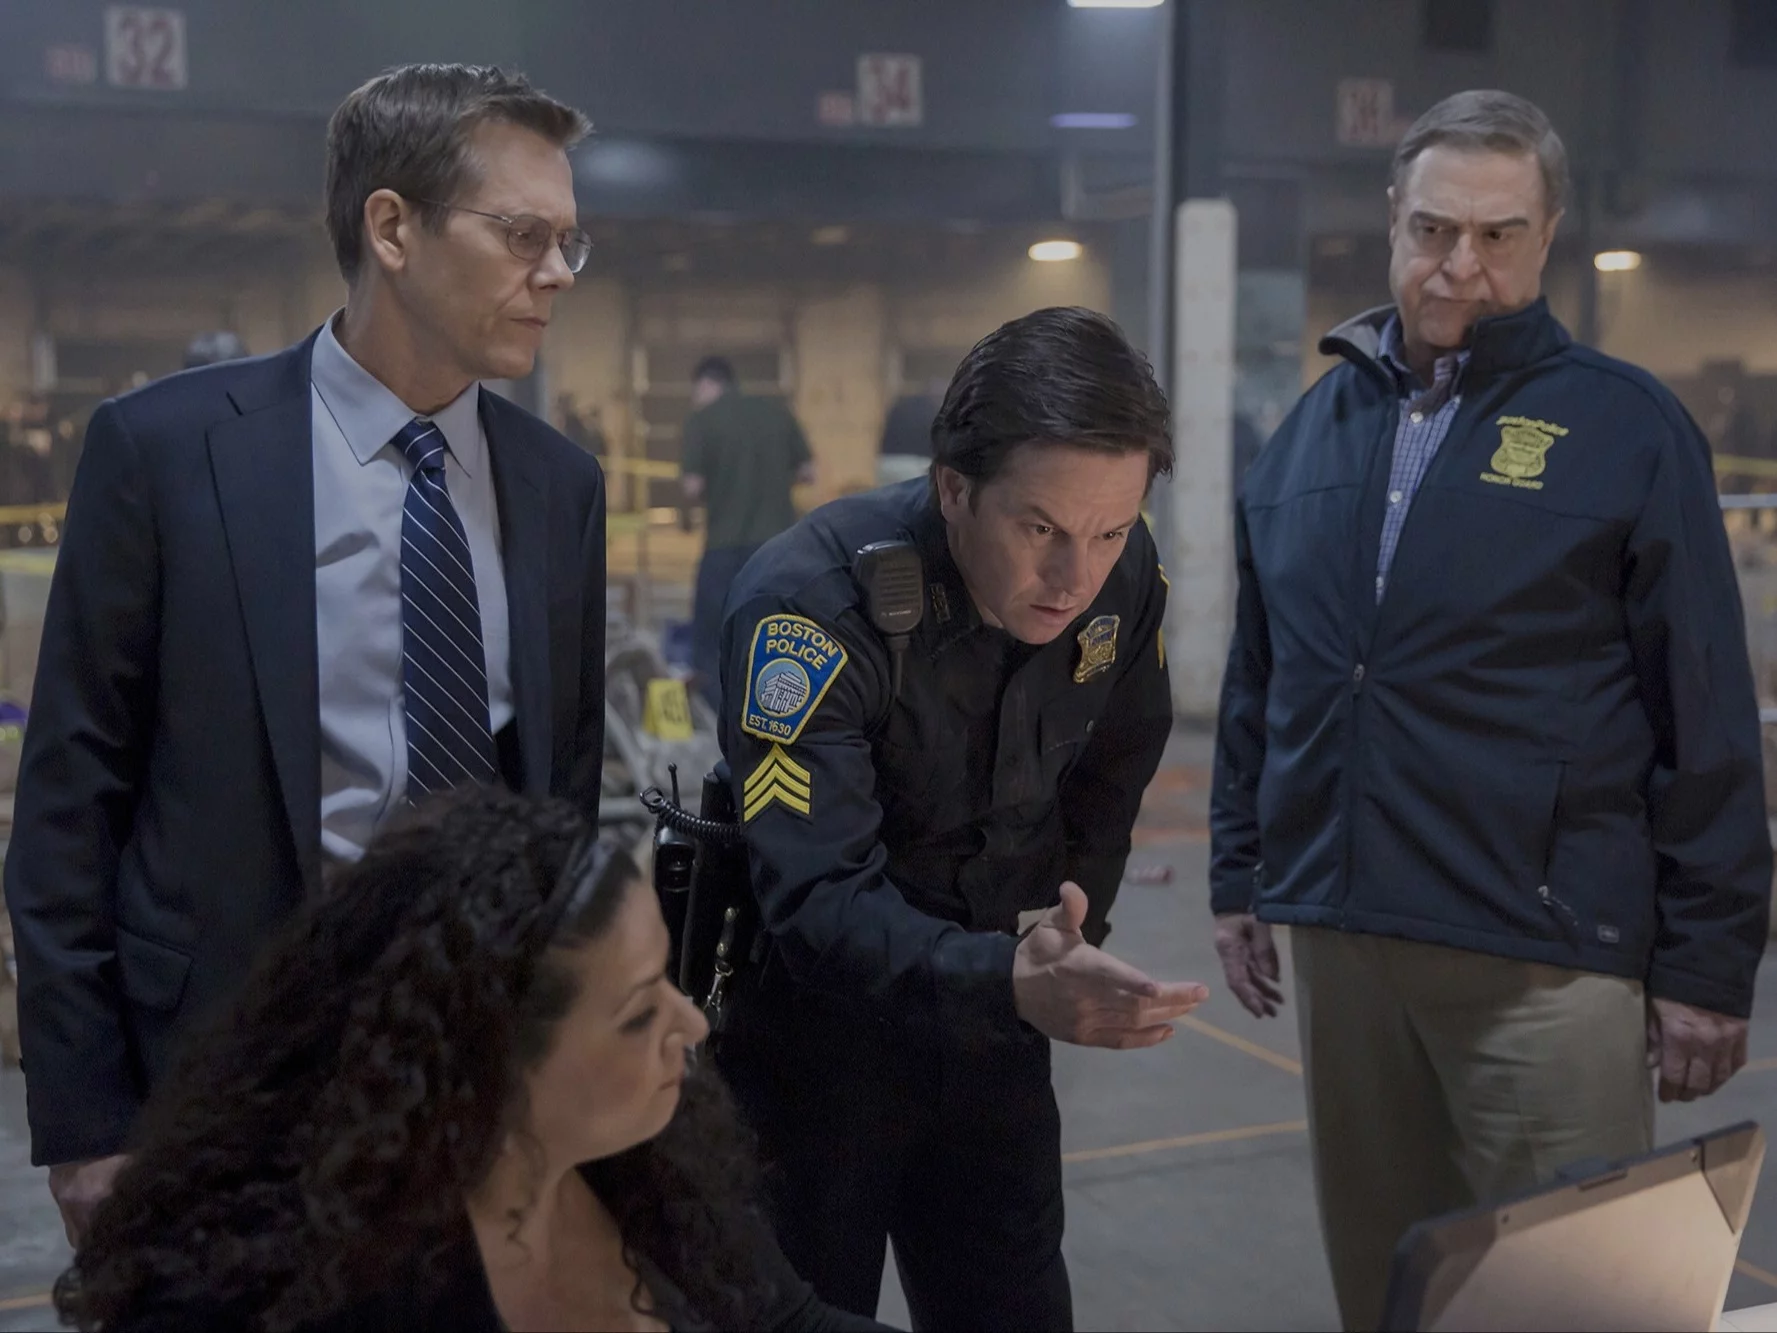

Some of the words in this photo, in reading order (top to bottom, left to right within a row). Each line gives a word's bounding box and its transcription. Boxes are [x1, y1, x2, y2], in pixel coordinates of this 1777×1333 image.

[118, 13, 176, 87] 32
[766, 639, 828, 670] POLICE
[767, 622, 838, 657] BOSTON
[748, 714, 769, 730] EST.
[768, 719, 791, 736] 1630
